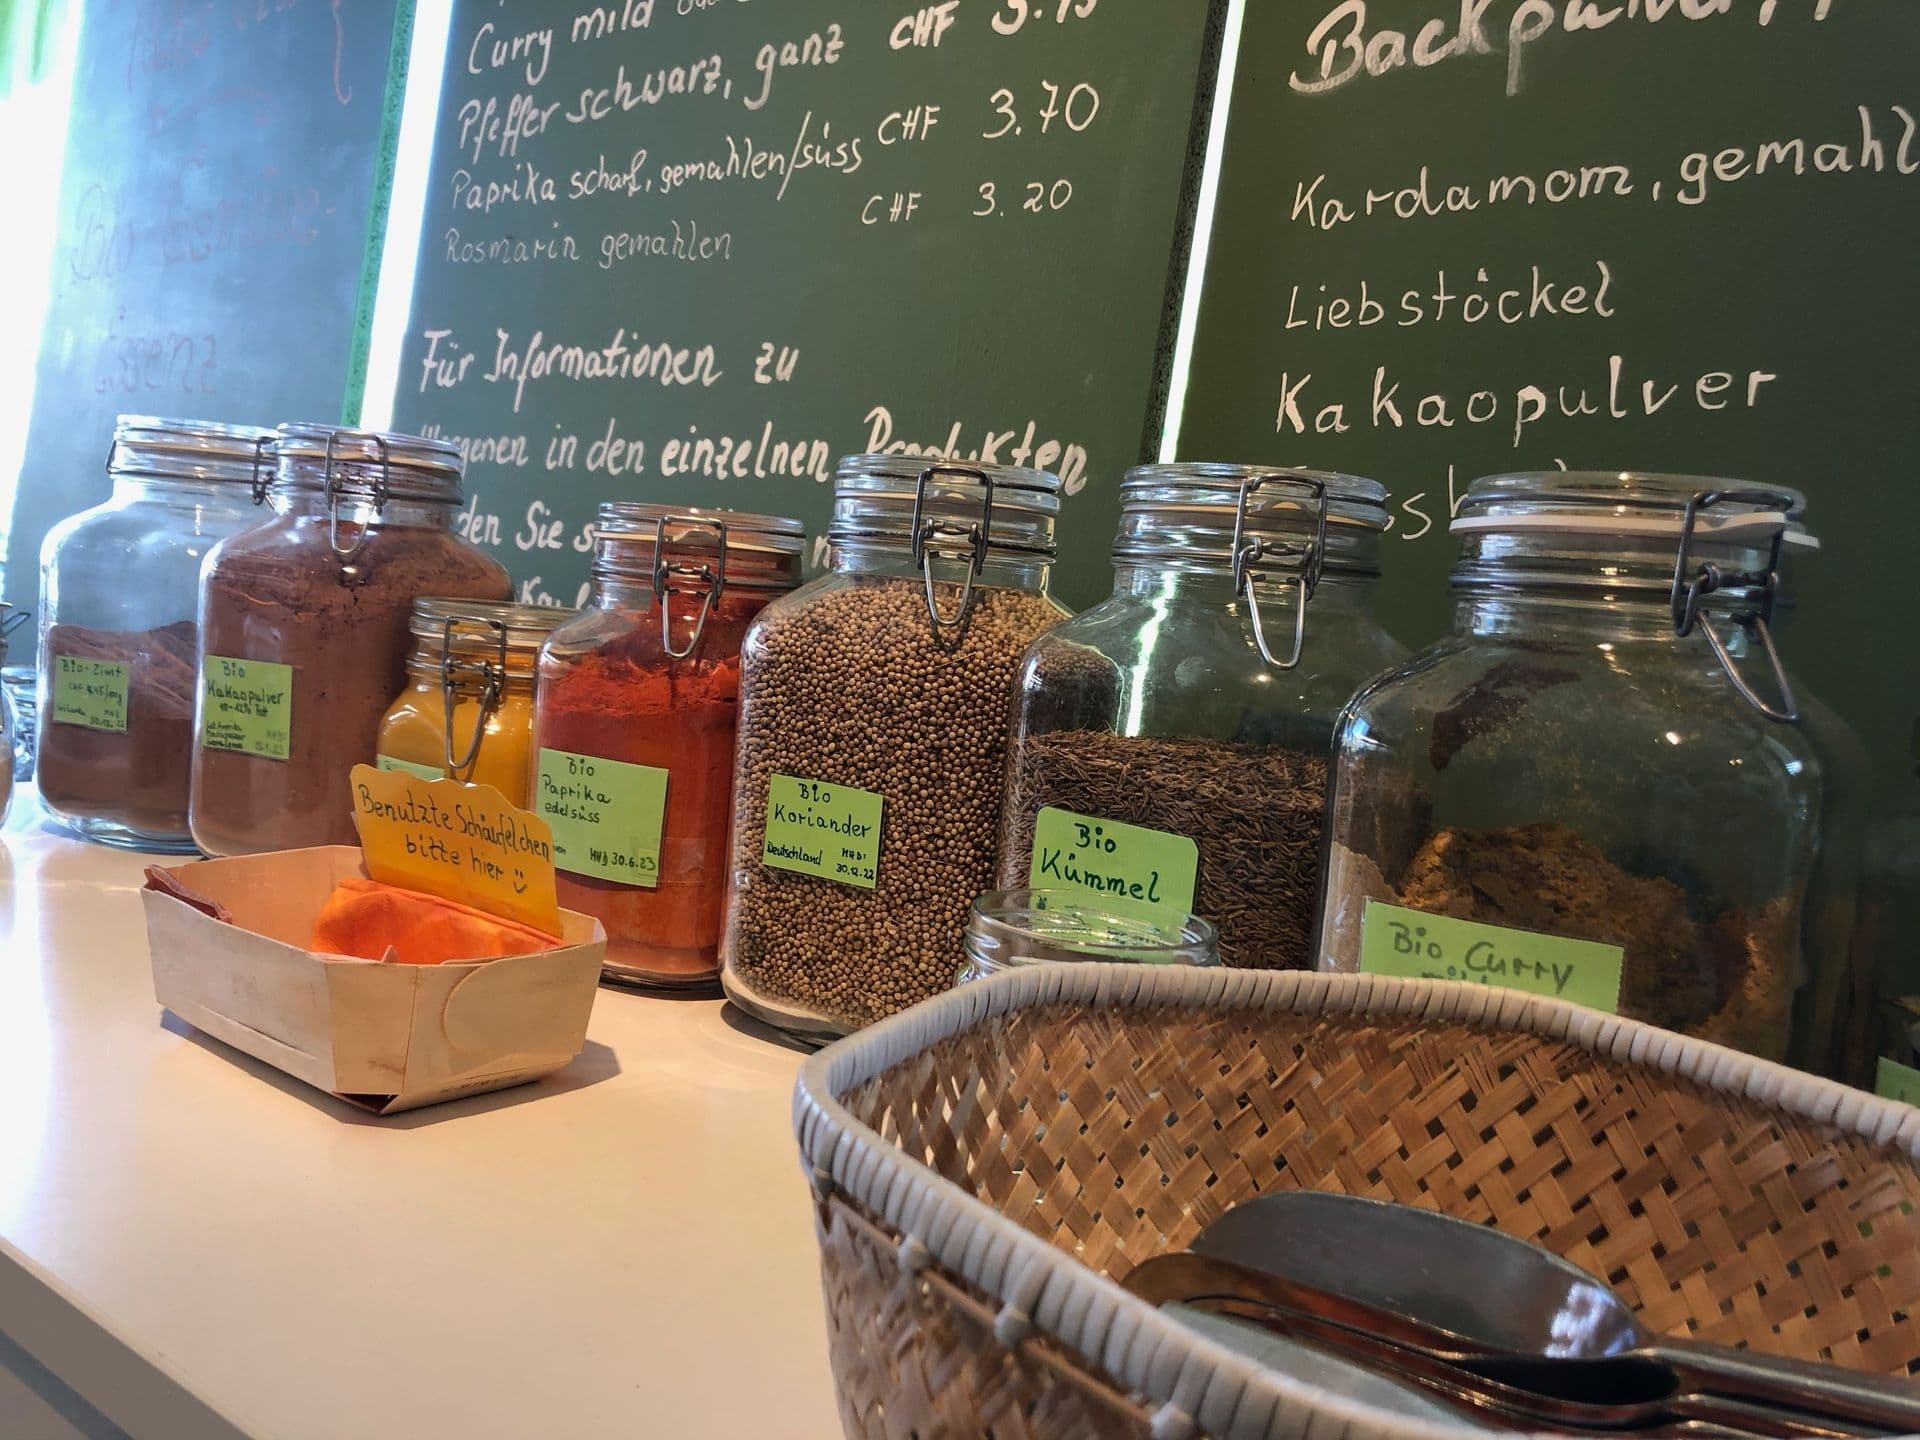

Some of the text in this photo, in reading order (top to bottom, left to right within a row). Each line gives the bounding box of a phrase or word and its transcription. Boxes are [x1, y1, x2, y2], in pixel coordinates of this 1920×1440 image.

[468, 0, 655, 86] Curry mild
[457, 93, 561, 164] Pfeffer
[566, 55, 731, 124] schwarz,
[744, 23, 845, 110] ganz
[889, 0, 960, 50] CHF
[451, 164, 556, 214] Paprika
[877, 106, 940, 146] CHF
[982, 80, 1100, 139] 3.70
[444, 222, 580, 264] Rosmarin
[599, 220, 732, 269] gemahlen
[861, 192, 922, 225] CHF
[1284, 260, 1616, 331] Liebstöckel
[420, 328, 800, 413] Für Informationen zu
[1275, 354, 1778, 448] Kakaopulver
[546, 423, 579, 471] in
[586, 417, 646, 476] den
[660, 419, 830, 483] einzelnen
[516, 500, 564, 551] Sie
[206, 680, 285, 705] Kakaopulver
[220, 661, 246, 678] Bio
[542, 773, 612, 804] Paprika
[565, 756, 596, 777] Bio
[798, 783, 832, 803] Bio
[358, 783, 550, 863] Benutzte Schäufelchen
[774, 803, 872, 838] Koriander
[1073, 822, 1118, 854] Bio
[405, 833, 505, 881] bitte hier
[611, 852, 657, 872] 30.6.23
[766, 841, 823, 867] Deutschland
[1040, 847, 1162, 904] Kümmel
[1388, 921, 1443, 961] Bio
[1463, 940, 1576, 995] Curry
